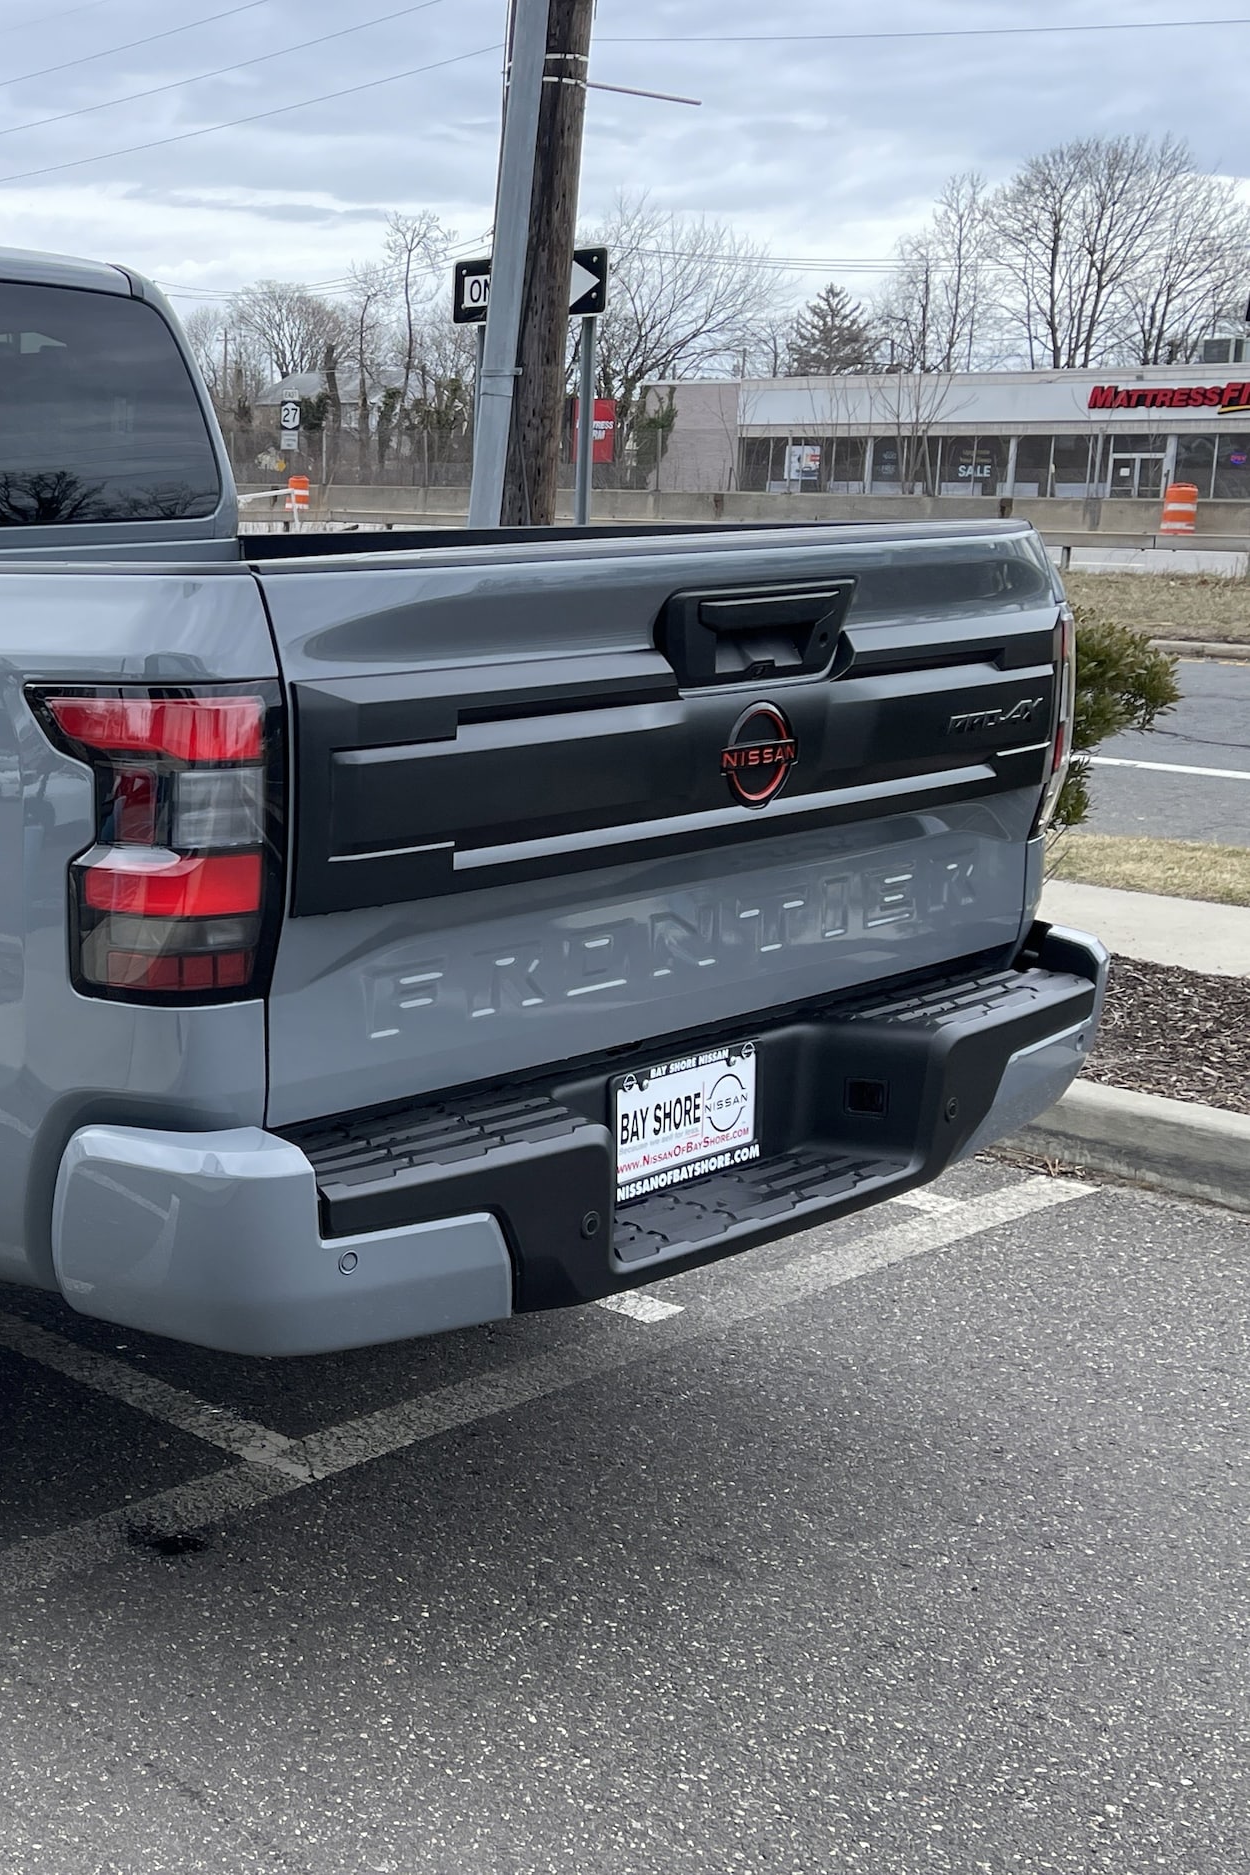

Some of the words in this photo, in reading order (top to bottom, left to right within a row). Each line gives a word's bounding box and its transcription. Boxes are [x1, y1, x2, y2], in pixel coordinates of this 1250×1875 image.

[470, 279, 491, 303] ON
[1088, 385, 1224, 409] MATTRESS
[283, 407, 298, 422] 27
[958, 465, 992, 477] SALE
[722, 746, 796, 768] NISSAN
[362, 846, 978, 1038] FRONTIER
[650, 1065, 668, 1079] BAY
[669, 1056, 697, 1074] SHORE
[698, 1048, 730, 1066] NISSAN
[704, 1092, 749, 1114] NISSAN
[620, 1106, 650, 1146] BAY
[653, 1092, 701, 1136] SHORE
[616, 1144, 760, 1202] NISSANOFBAYSHORE.COM
